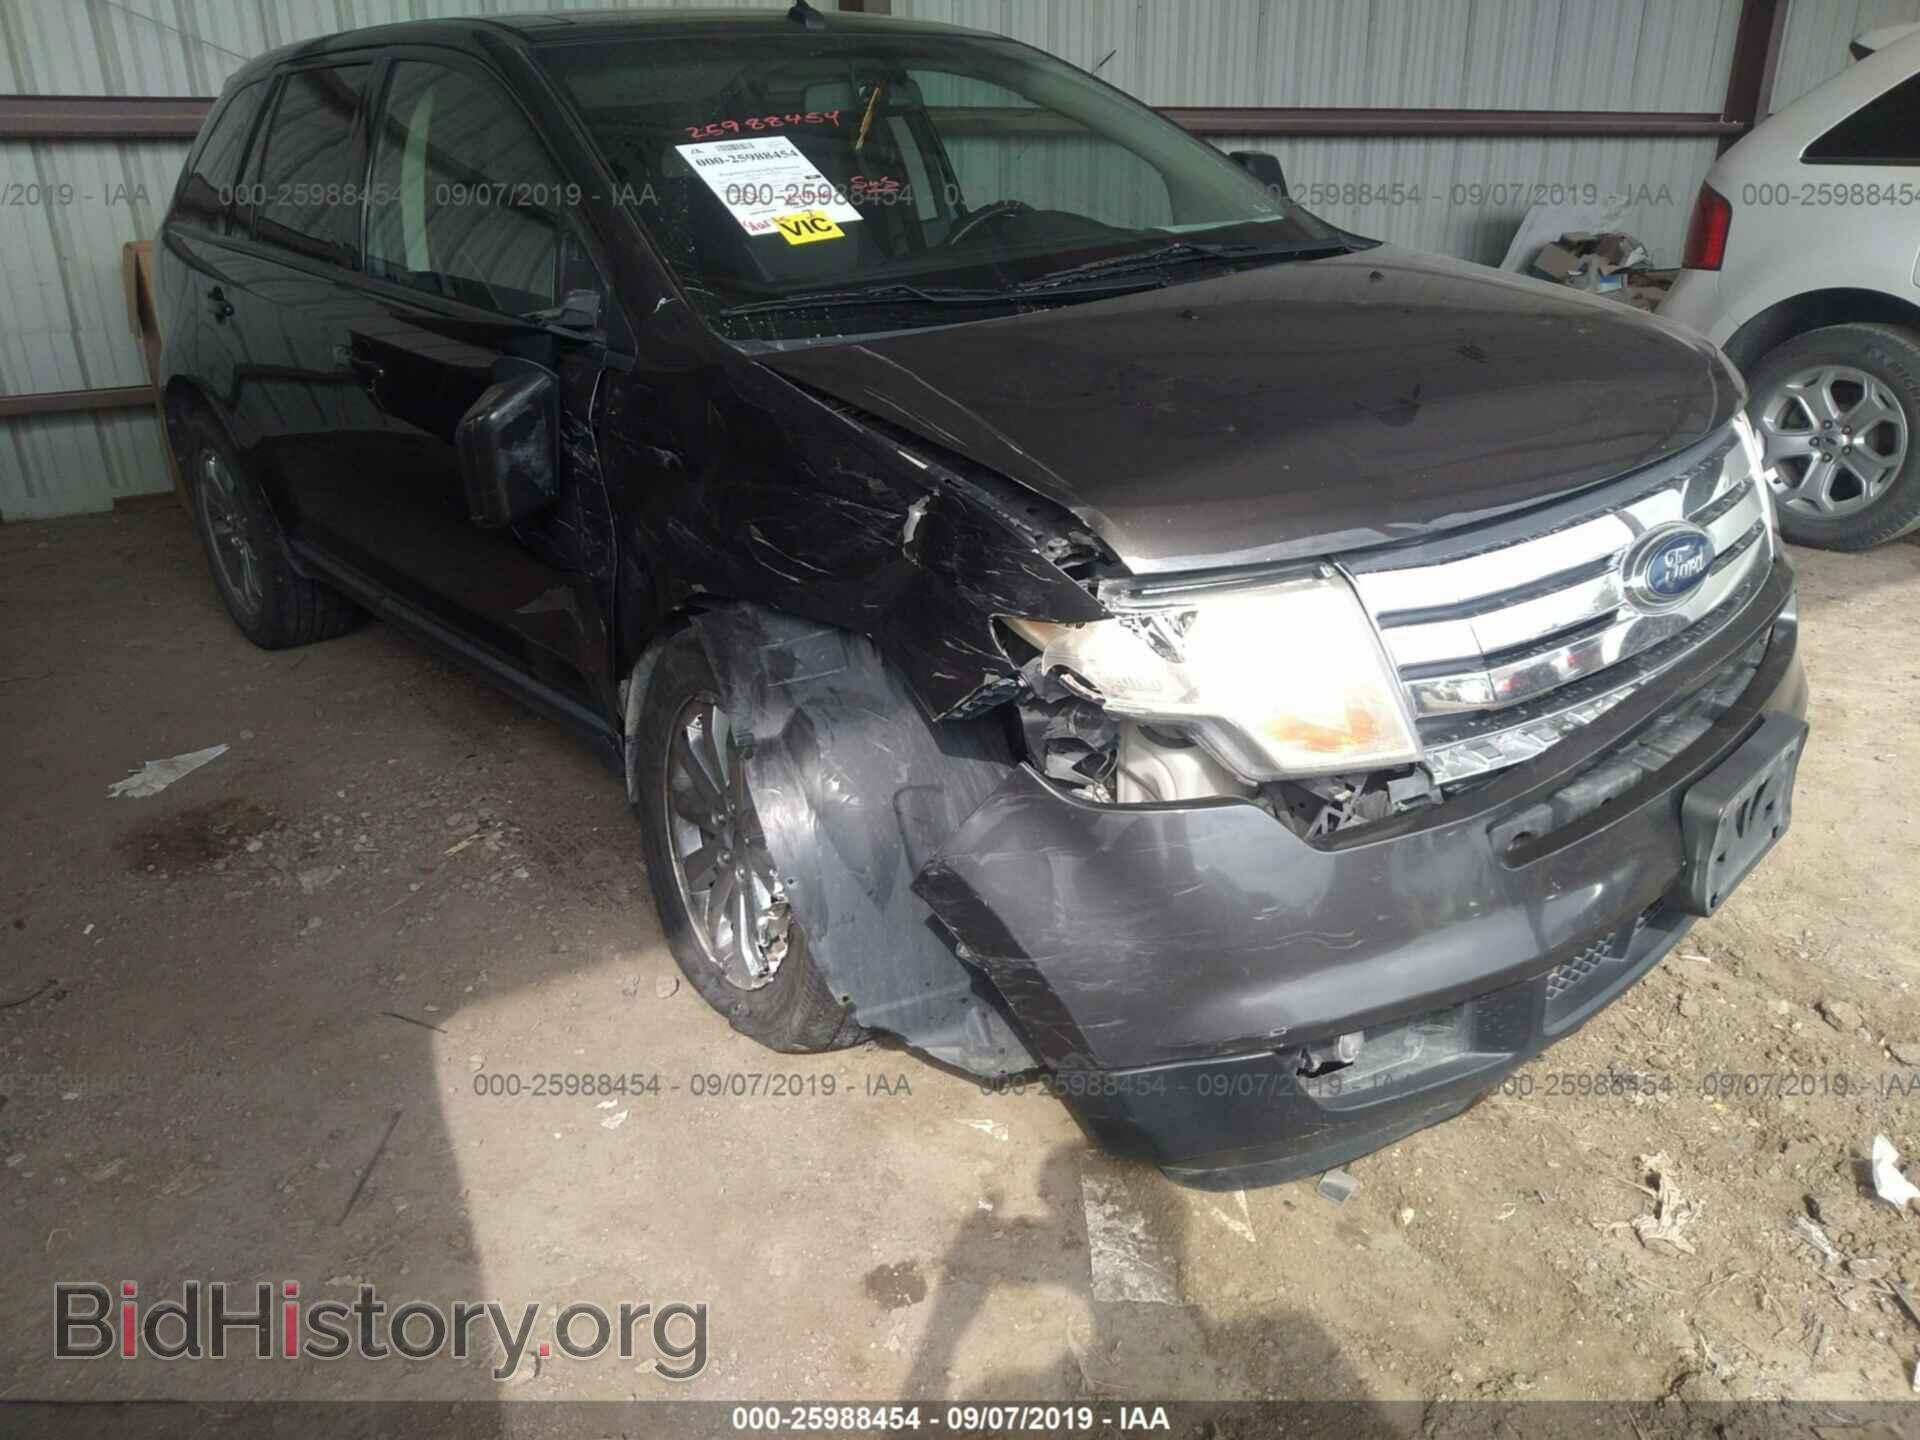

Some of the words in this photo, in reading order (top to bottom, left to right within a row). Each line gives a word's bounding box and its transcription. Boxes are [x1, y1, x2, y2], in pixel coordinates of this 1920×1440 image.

[685, 110, 840, 138] 25988454
[695, 149, 799, 167] 000-25988454
[780, 217, 833, 237] VIC
[1663, 544, 1705, 584] Ford
